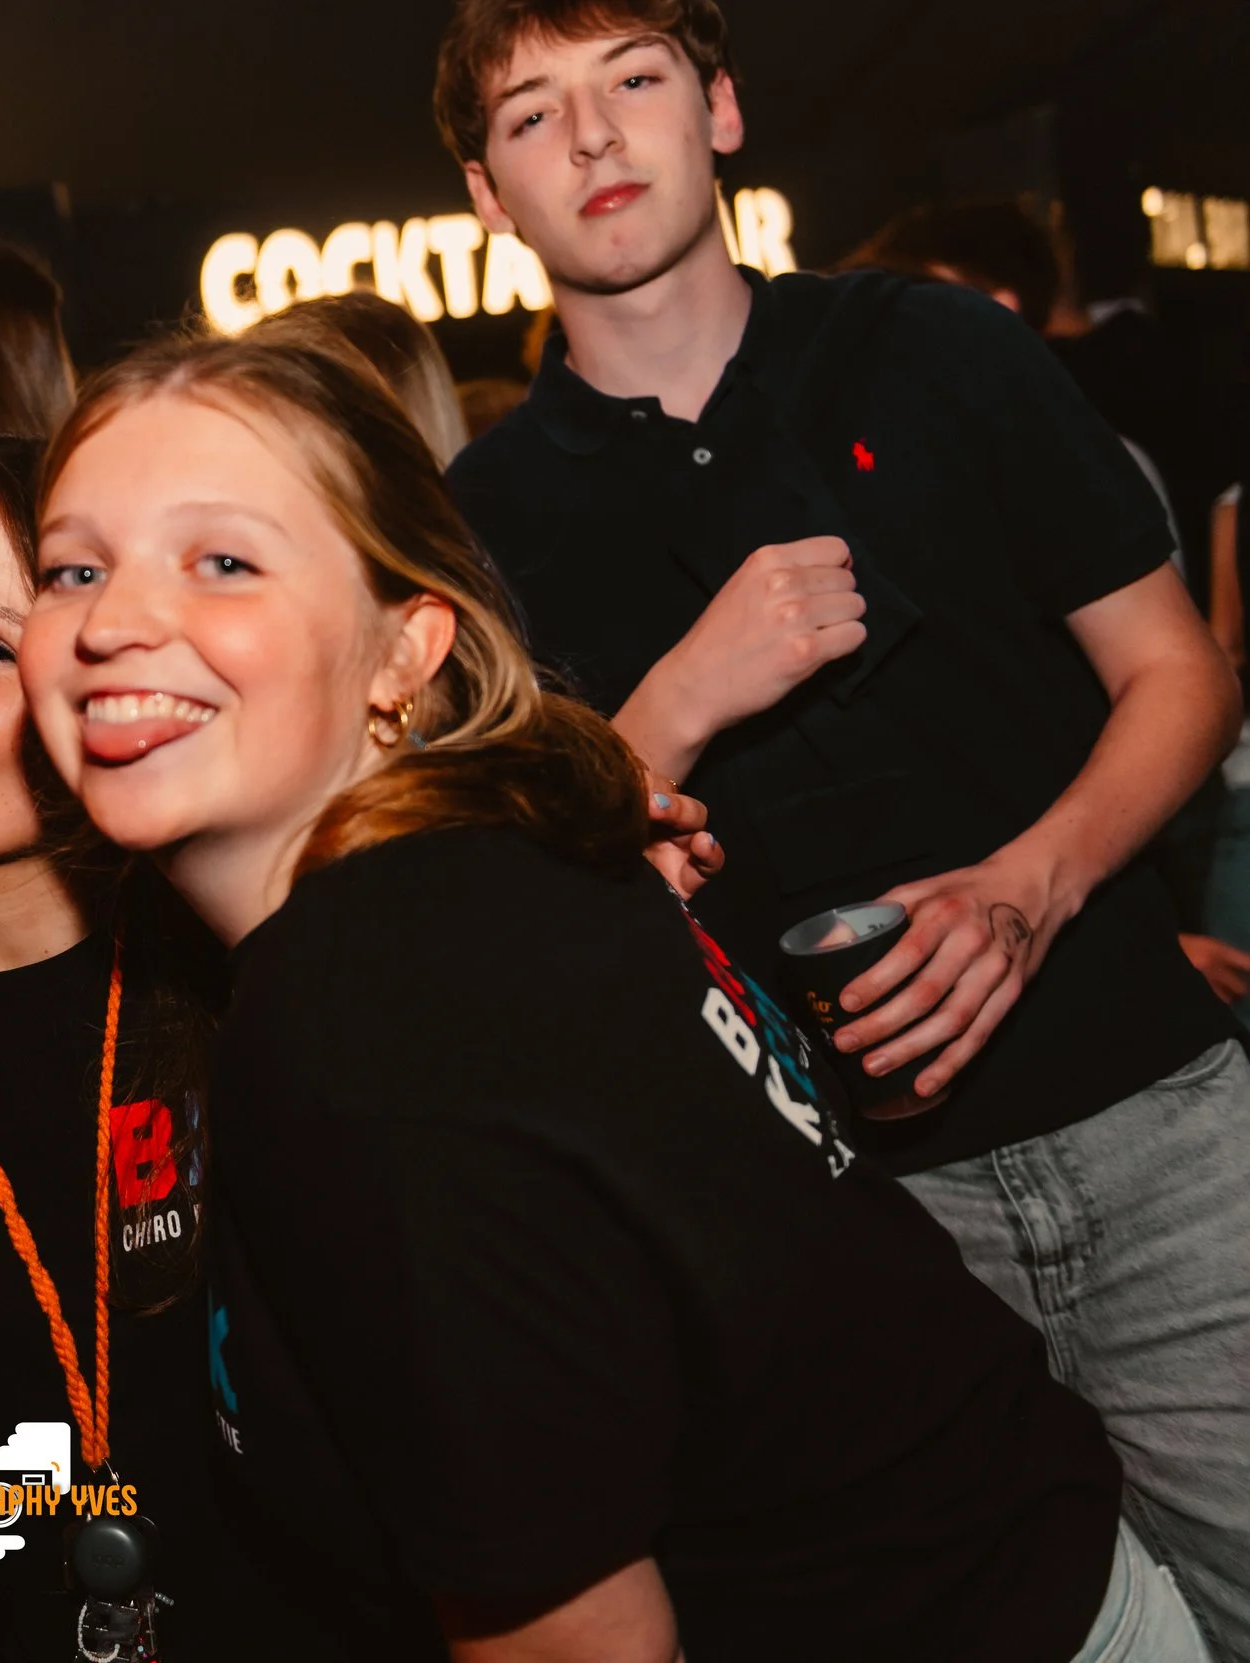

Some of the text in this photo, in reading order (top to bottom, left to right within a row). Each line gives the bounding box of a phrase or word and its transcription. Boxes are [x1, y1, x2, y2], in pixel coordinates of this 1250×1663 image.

[200, 213, 554, 338] COCKTA
[701, 987, 760, 1076] B
[109, 1099, 178, 1208] B
[122, 1209, 182, 1252] CHIRO
